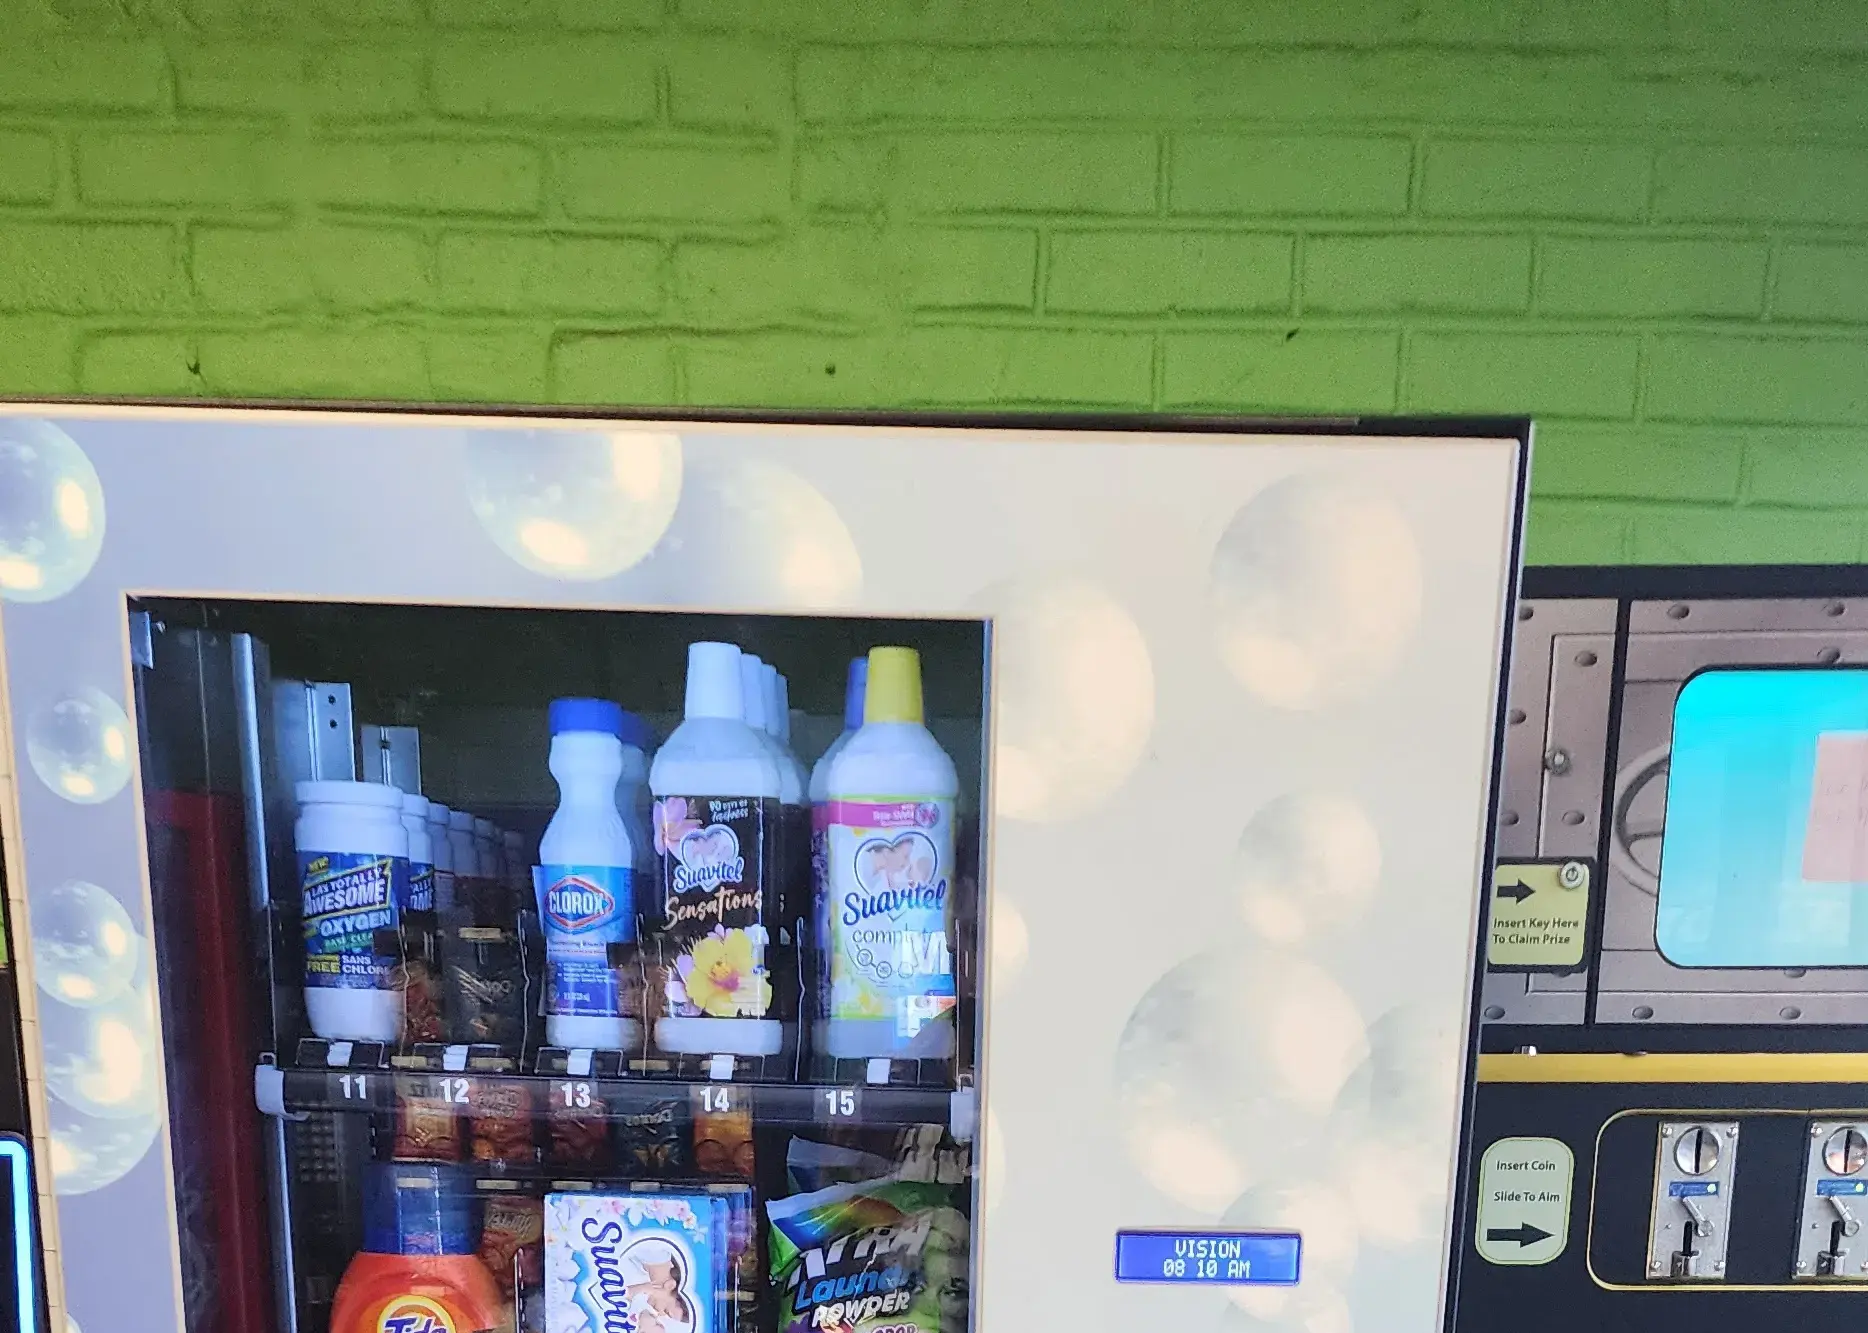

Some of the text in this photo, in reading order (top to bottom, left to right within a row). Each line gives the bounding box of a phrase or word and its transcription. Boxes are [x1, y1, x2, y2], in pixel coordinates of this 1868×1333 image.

[332, 867, 383, 890] TOTALLY
[676, 860, 742, 890] Suavitel
[303, 879, 386, 917] AWESOME
[549, 891, 606, 915] CLOROX
[661, 886, 763, 931] Sensations
[843, 879, 946, 926] Suavitel
[320, 909, 392, 937] OXYGEN
[1493, 917, 1580, 933] Insert Key Here
[1493, 931, 1571, 946] To Claim Prize
[341, 954, 372, 966] SANS
[340, 1075, 365, 1098] 11
[439, 1078, 470, 1103] 12
[561, 1082, 590, 1107] 13
[700, 1086, 729, 1112] 14
[826, 1090, 854, 1115] 15
[1495, 1159, 1557, 1172] Insert Coin
[1493, 1190, 1562, 1204] Slide To Aim
[1174, 1239, 1241, 1259] VISION
[1163, 1259, 1251, 1278] 08 10 AM
[812, 1290, 910, 1329] POWDER
